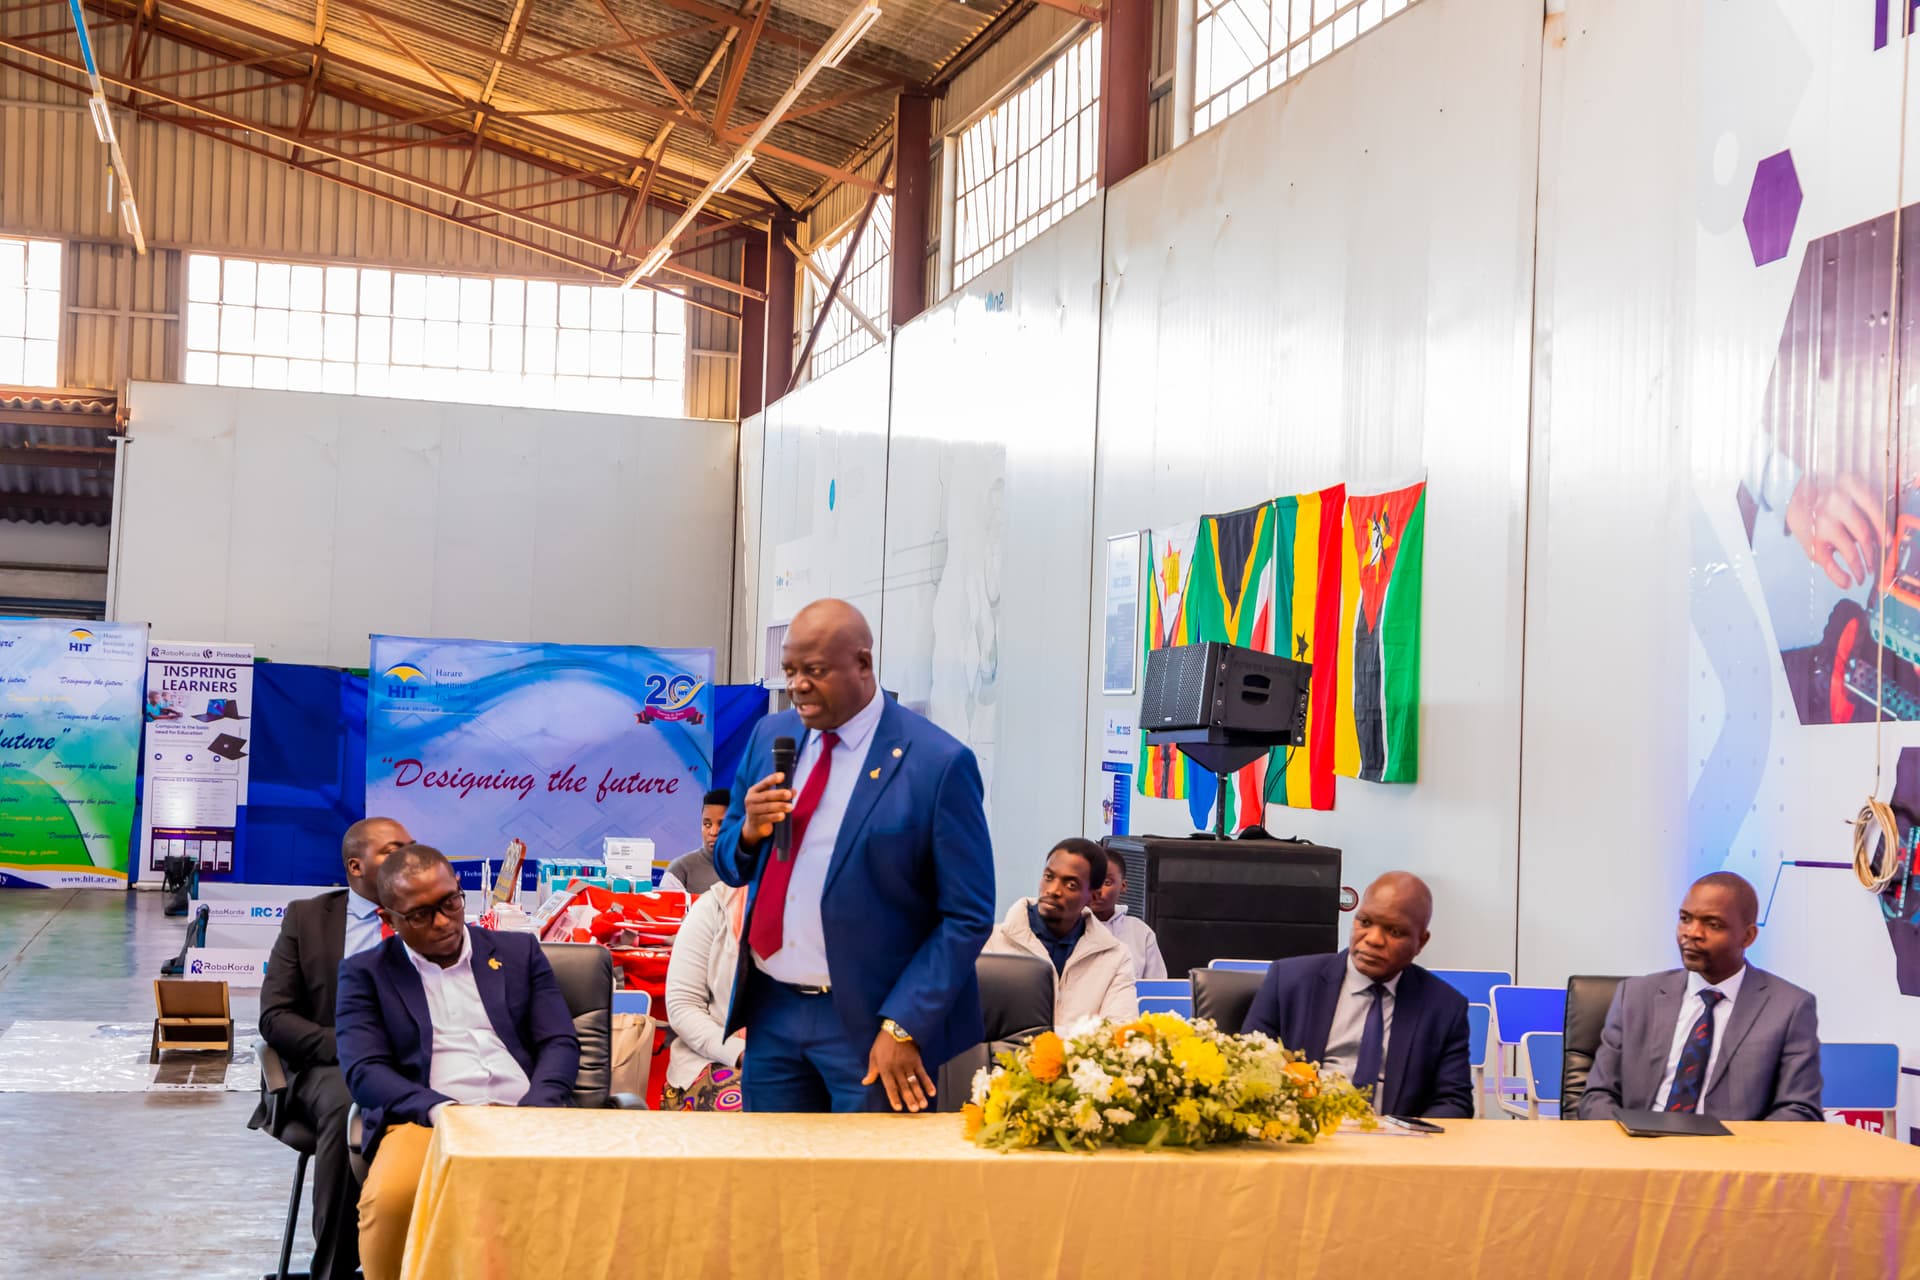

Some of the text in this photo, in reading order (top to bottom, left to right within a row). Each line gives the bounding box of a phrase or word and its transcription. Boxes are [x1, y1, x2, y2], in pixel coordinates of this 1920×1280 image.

[69, 642, 91, 652] HIT
[164, 665, 237, 679] INSPRING
[435, 668, 464, 679] Harare
[162, 679, 238, 693] LEARNERS
[387, 684, 420, 699] HIT
[548, 764, 588, 794] the
[251, 907, 272, 917] IRC
[204, 963, 254, 971] RoboKorda
